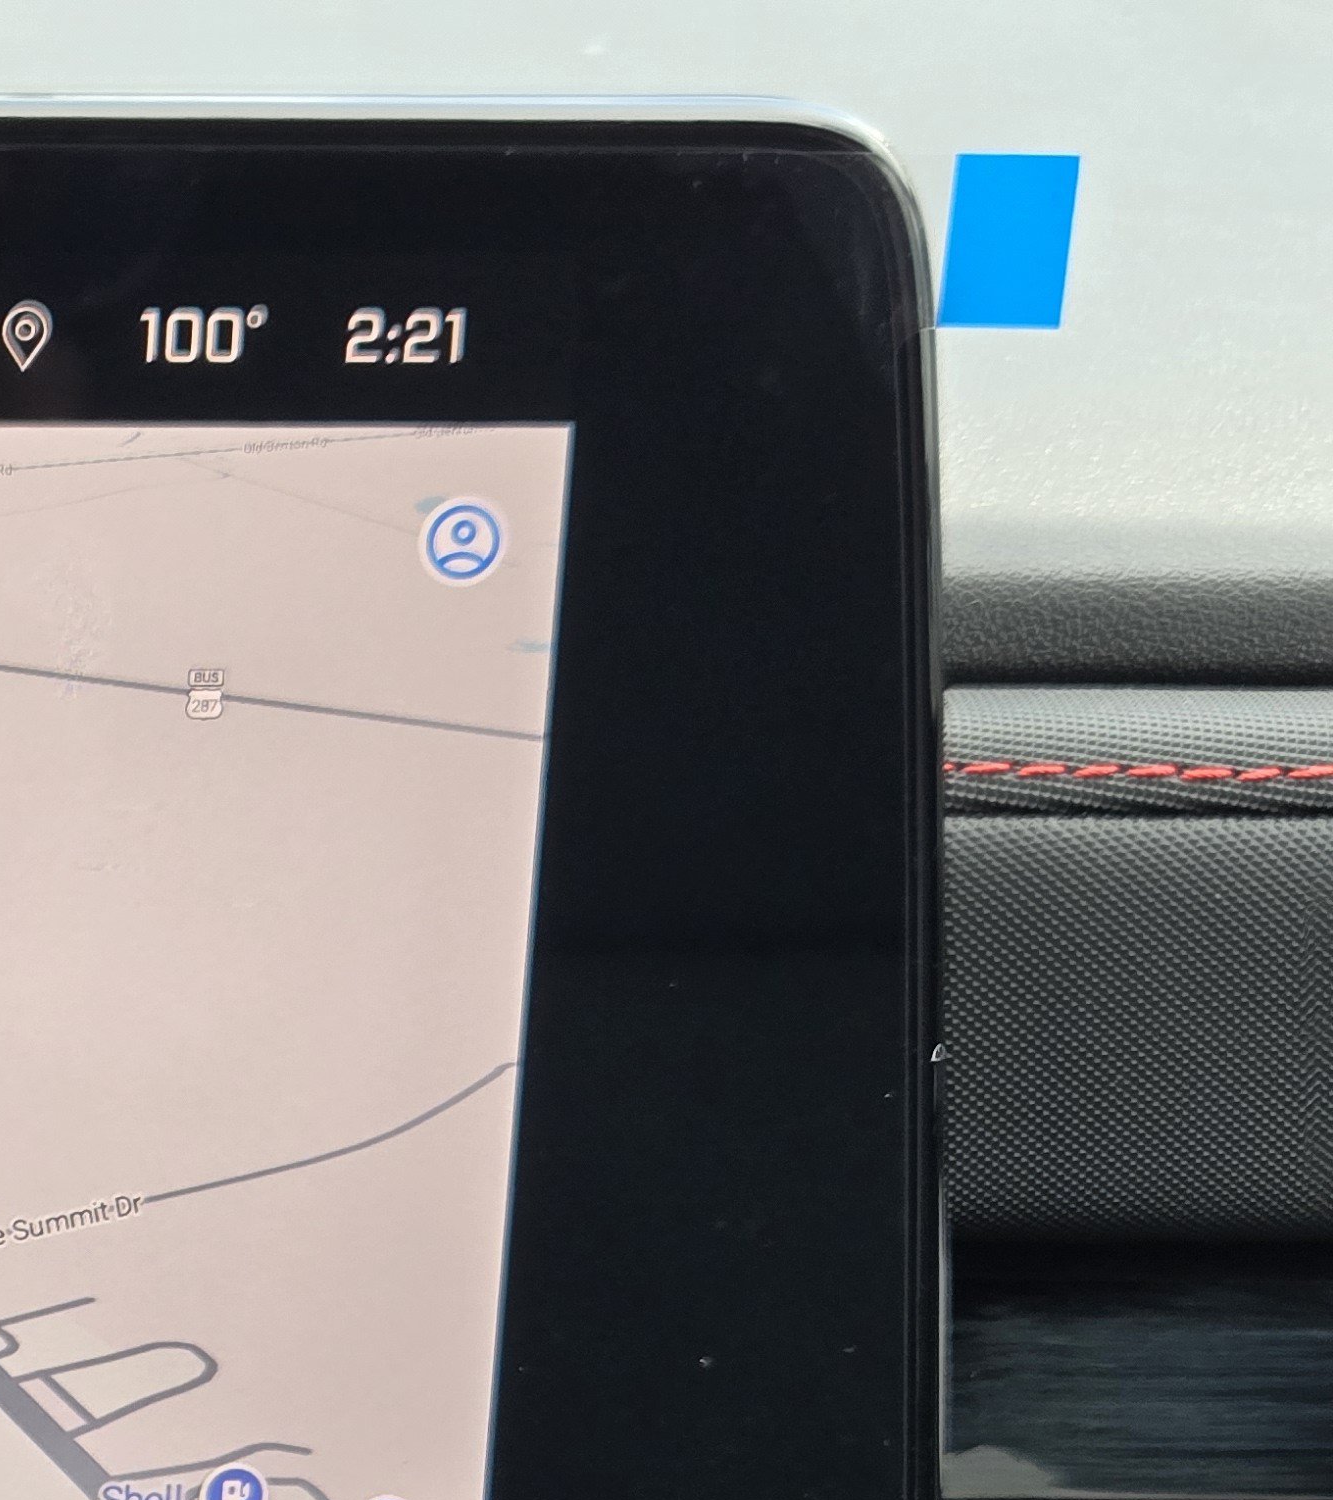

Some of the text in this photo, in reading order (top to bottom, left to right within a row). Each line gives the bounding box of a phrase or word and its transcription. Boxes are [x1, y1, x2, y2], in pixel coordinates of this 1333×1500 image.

[139, 303, 269, 365] 100°
[344, 306, 469, 366] 2:21
[193, 671, 220, 683] BUS
[191, 698, 219, 714] 287
[12, 1200, 111, 1242] Summit
[114, 1194, 144, 1219] Dr
